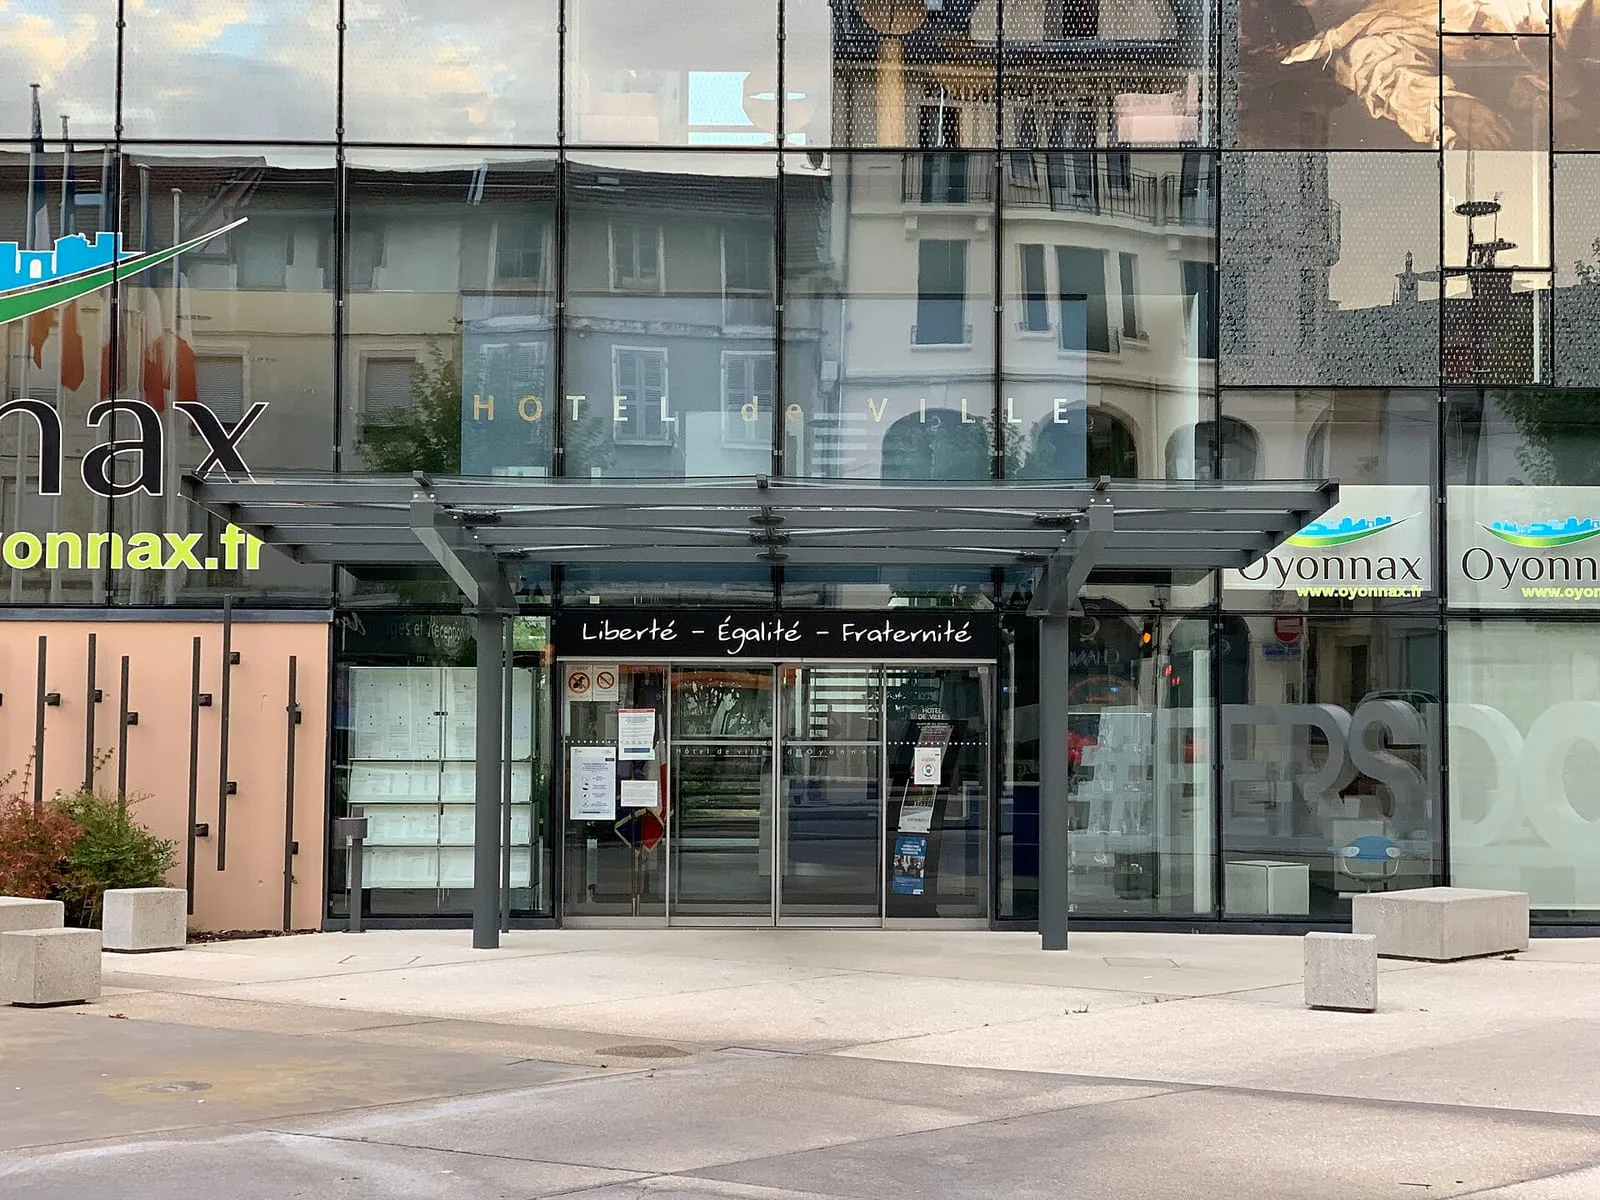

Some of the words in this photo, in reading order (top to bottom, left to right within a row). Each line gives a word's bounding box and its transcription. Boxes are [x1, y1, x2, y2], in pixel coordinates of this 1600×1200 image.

[473, 395, 675, 421] HOTEL
[741, 396, 802, 422] de
[867, 398, 1068, 424] VILLE
[0, 522, 265, 570] onnax.fr
[1461, 546, 1600, 590] Oyonn
[1297, 585, 1423, 601] www.oyonnax.fr
[582, 616, 678, 641] Liberté
[717, 615, 803, 655] Égalité
[841, 619, 973, 643] Fraternité
